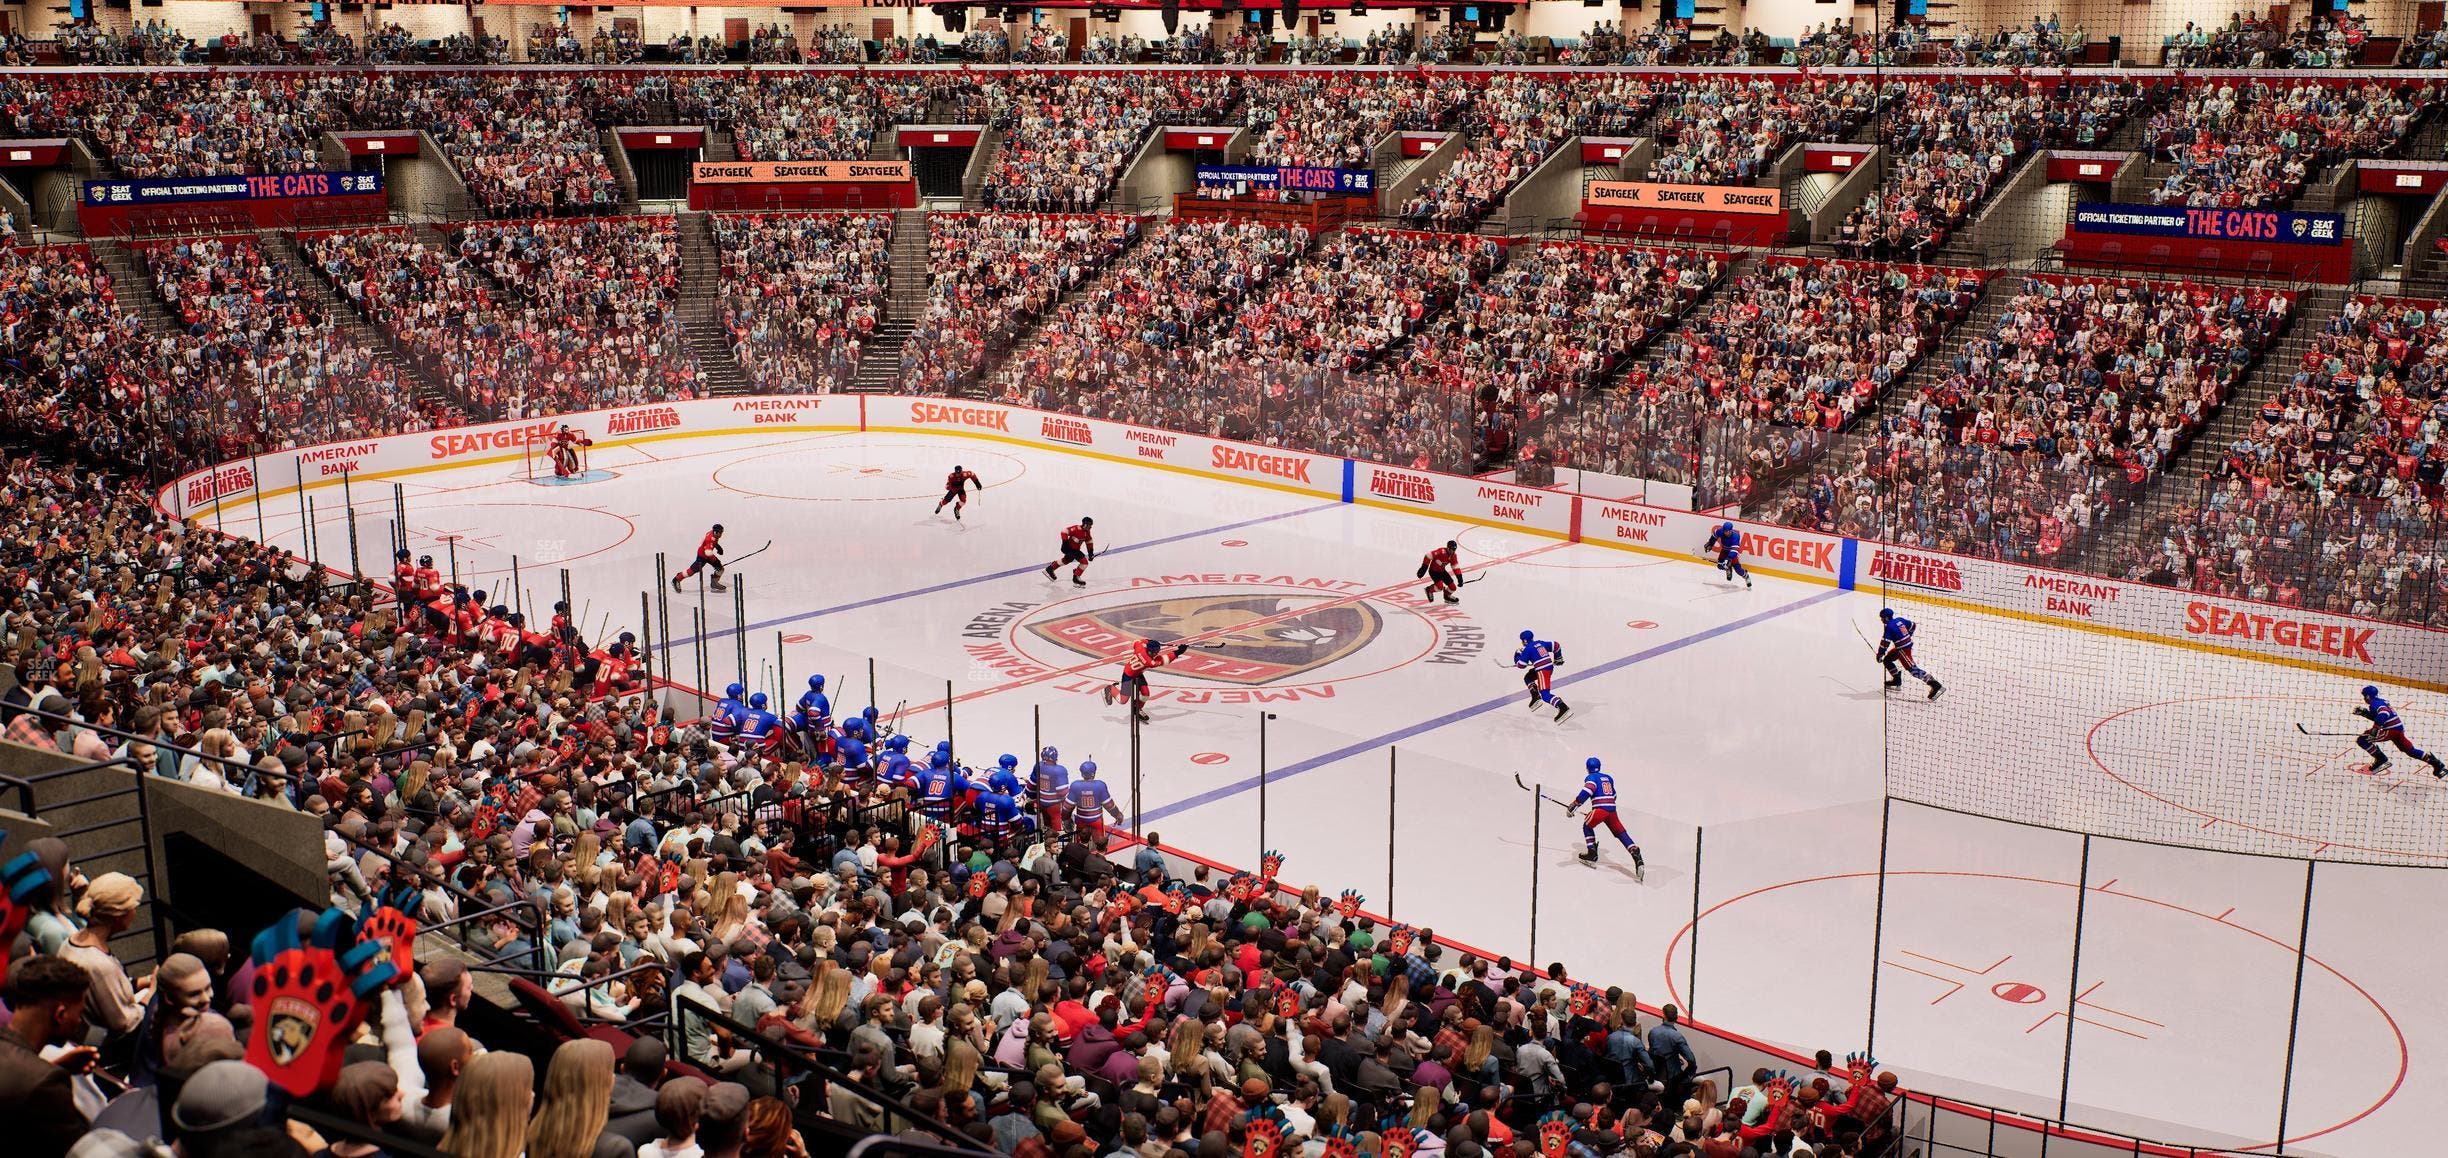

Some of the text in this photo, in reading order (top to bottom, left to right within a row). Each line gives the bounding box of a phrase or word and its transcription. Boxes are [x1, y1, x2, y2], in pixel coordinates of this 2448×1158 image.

[699, 165, 904, 179] SEATGEEK SEATGEEK SEATGEEK
[1197, 168, 1336, 189] OFFICIAL TICKETING PARTNER OF THE CATS
[111, 185, 131, 193] SEAT
[141, 174, 329, 197] OFFICIAL TICKETING PARTNER OF THE CATS
[111, 193, 132, 201] GEEK
[1594, 187, 1773, 207] SEATGEEK SEATGEEK SEATGEEK
[2079, 210, 2278, 238] OFFICIAL TICKETING PARTNER OF THE CATS
[2311, 228, 2333, 239] GEEK
[2313, 220, 2335, 229] SEAT
[610, 406, 675, 420] FLORIDA
[733, 400, 822, 411] AMERANT
[607, 412, 681, 434] PANTHERS
[754, 413, 797, 424] BANK
[911, 402, 1010, 433] SEATGEEK
[1043, 416, 1089, 430] FLORIDA
[431, 421, 557, 459] SEATGEEK
[1041, 423, 1093, 444] PANTHERS
[1126, 430, 1177, 447] AMERANT
[301, 443, 379, 464] AMERANT
[1138, 445, 1163, 460] BANK
[321, 460, 359, 476] BANK
[1211, 444, 1311, 484] SEATGEEK
[188, 465, 249, 490] FLORIDA
[1373, 469, 1432, 486] FLORIDA
[187, 472, 255, 507] PANTHERS
[1370, 477, 1435, 502] PANTHERS
[1477, 486, 1543, 507] AMERANT
[1493, 505, 1525, 521] BANK
[1601, 506, 1667, 528] AMERANT
[1617, 525, 1648, 542] BANK
[1874, 549, 1957, 571] FLORIDA
[1868, 556, 1962, 591] PANTHERS
[2025, 574, 2119, 602] AMERANT
[2046, 597, 2093, 618] BANK
[961, 601, 1041, 639] ARENA
[1131, 573, 1367, 591] AMERANT
[1423, 623, 1485, 665] ARENA
[2185, 601, 2376, 664] SEATGEEK
[963, 641, 1047, 679] BANK
[928, 781, 945, 796] 00
